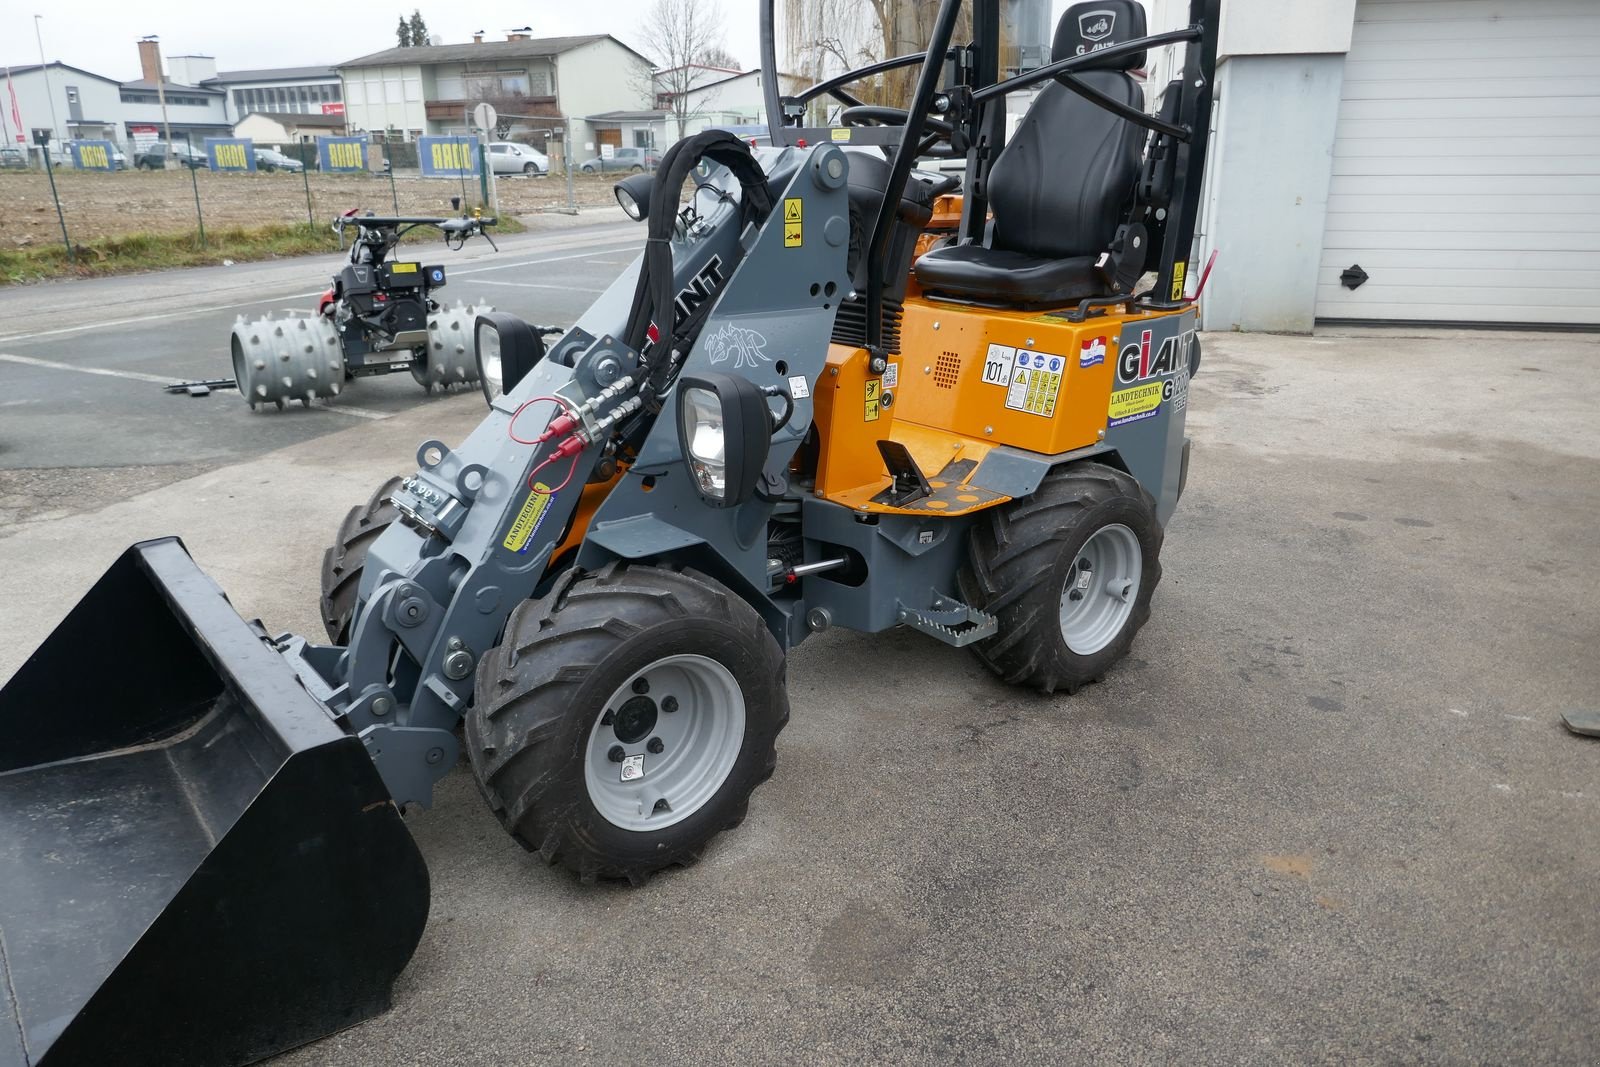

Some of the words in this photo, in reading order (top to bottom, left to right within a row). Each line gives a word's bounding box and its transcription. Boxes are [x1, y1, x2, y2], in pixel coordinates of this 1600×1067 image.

[986, 361, 1003, 382] 101
[1111, 385, 1160, 405] LANDTECHNIK
[1110, 410, 1157, 427] www.landtechnik.co.at
